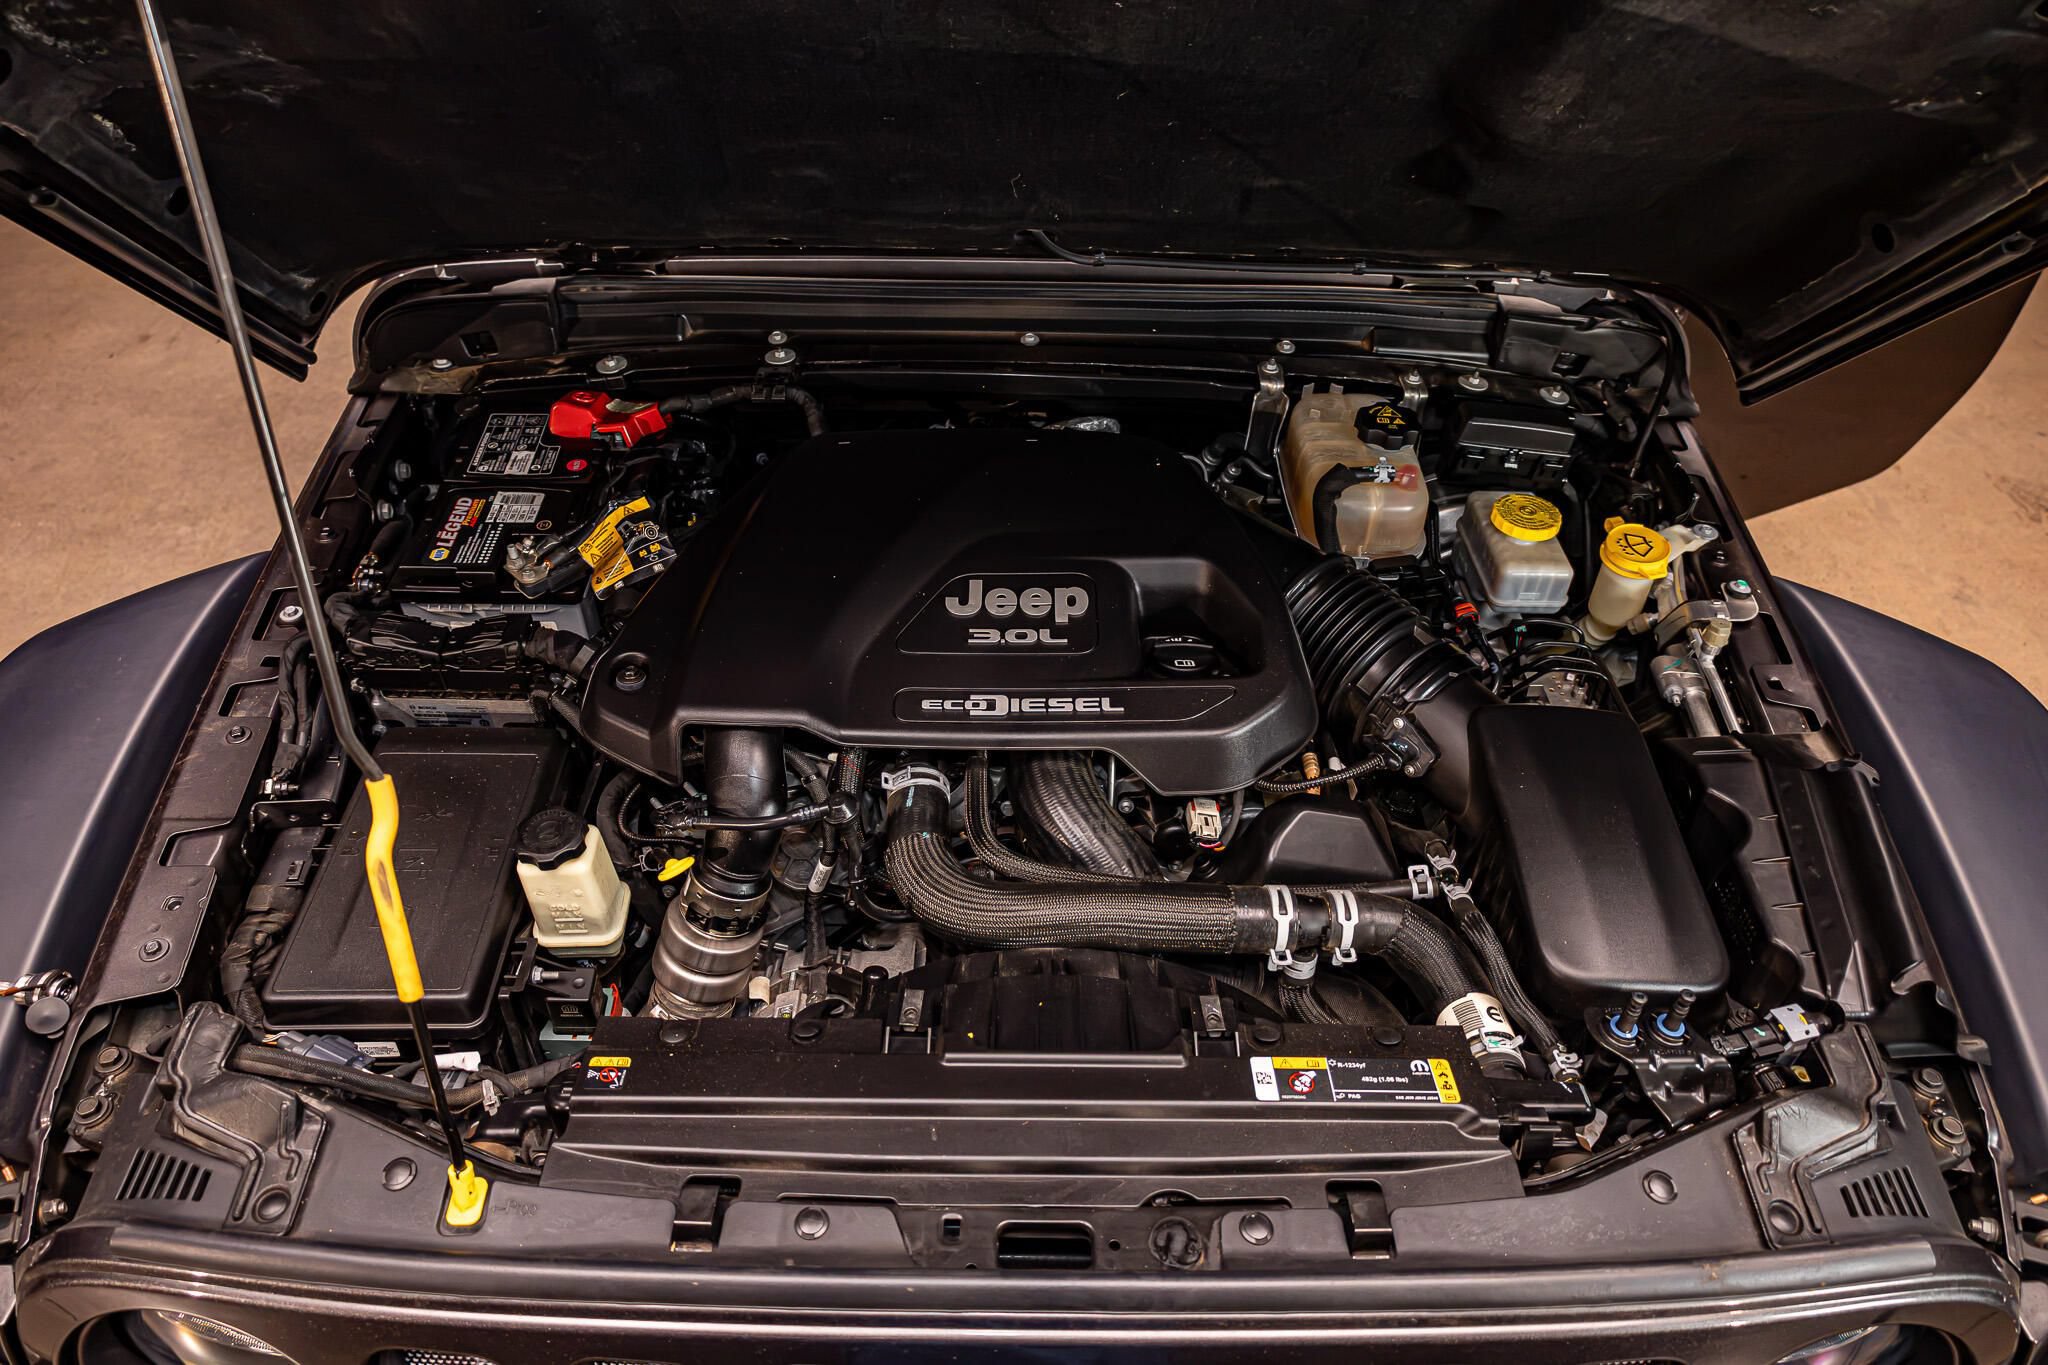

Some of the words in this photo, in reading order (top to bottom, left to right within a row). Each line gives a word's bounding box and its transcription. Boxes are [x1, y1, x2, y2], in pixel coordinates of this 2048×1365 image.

[436, 497, 473, 547] LEGEND
[461, 498, 480, 526] Premium
[945, 579, 1090, 624] Jeep
[967, 628, 1069, 645] 3.0L
